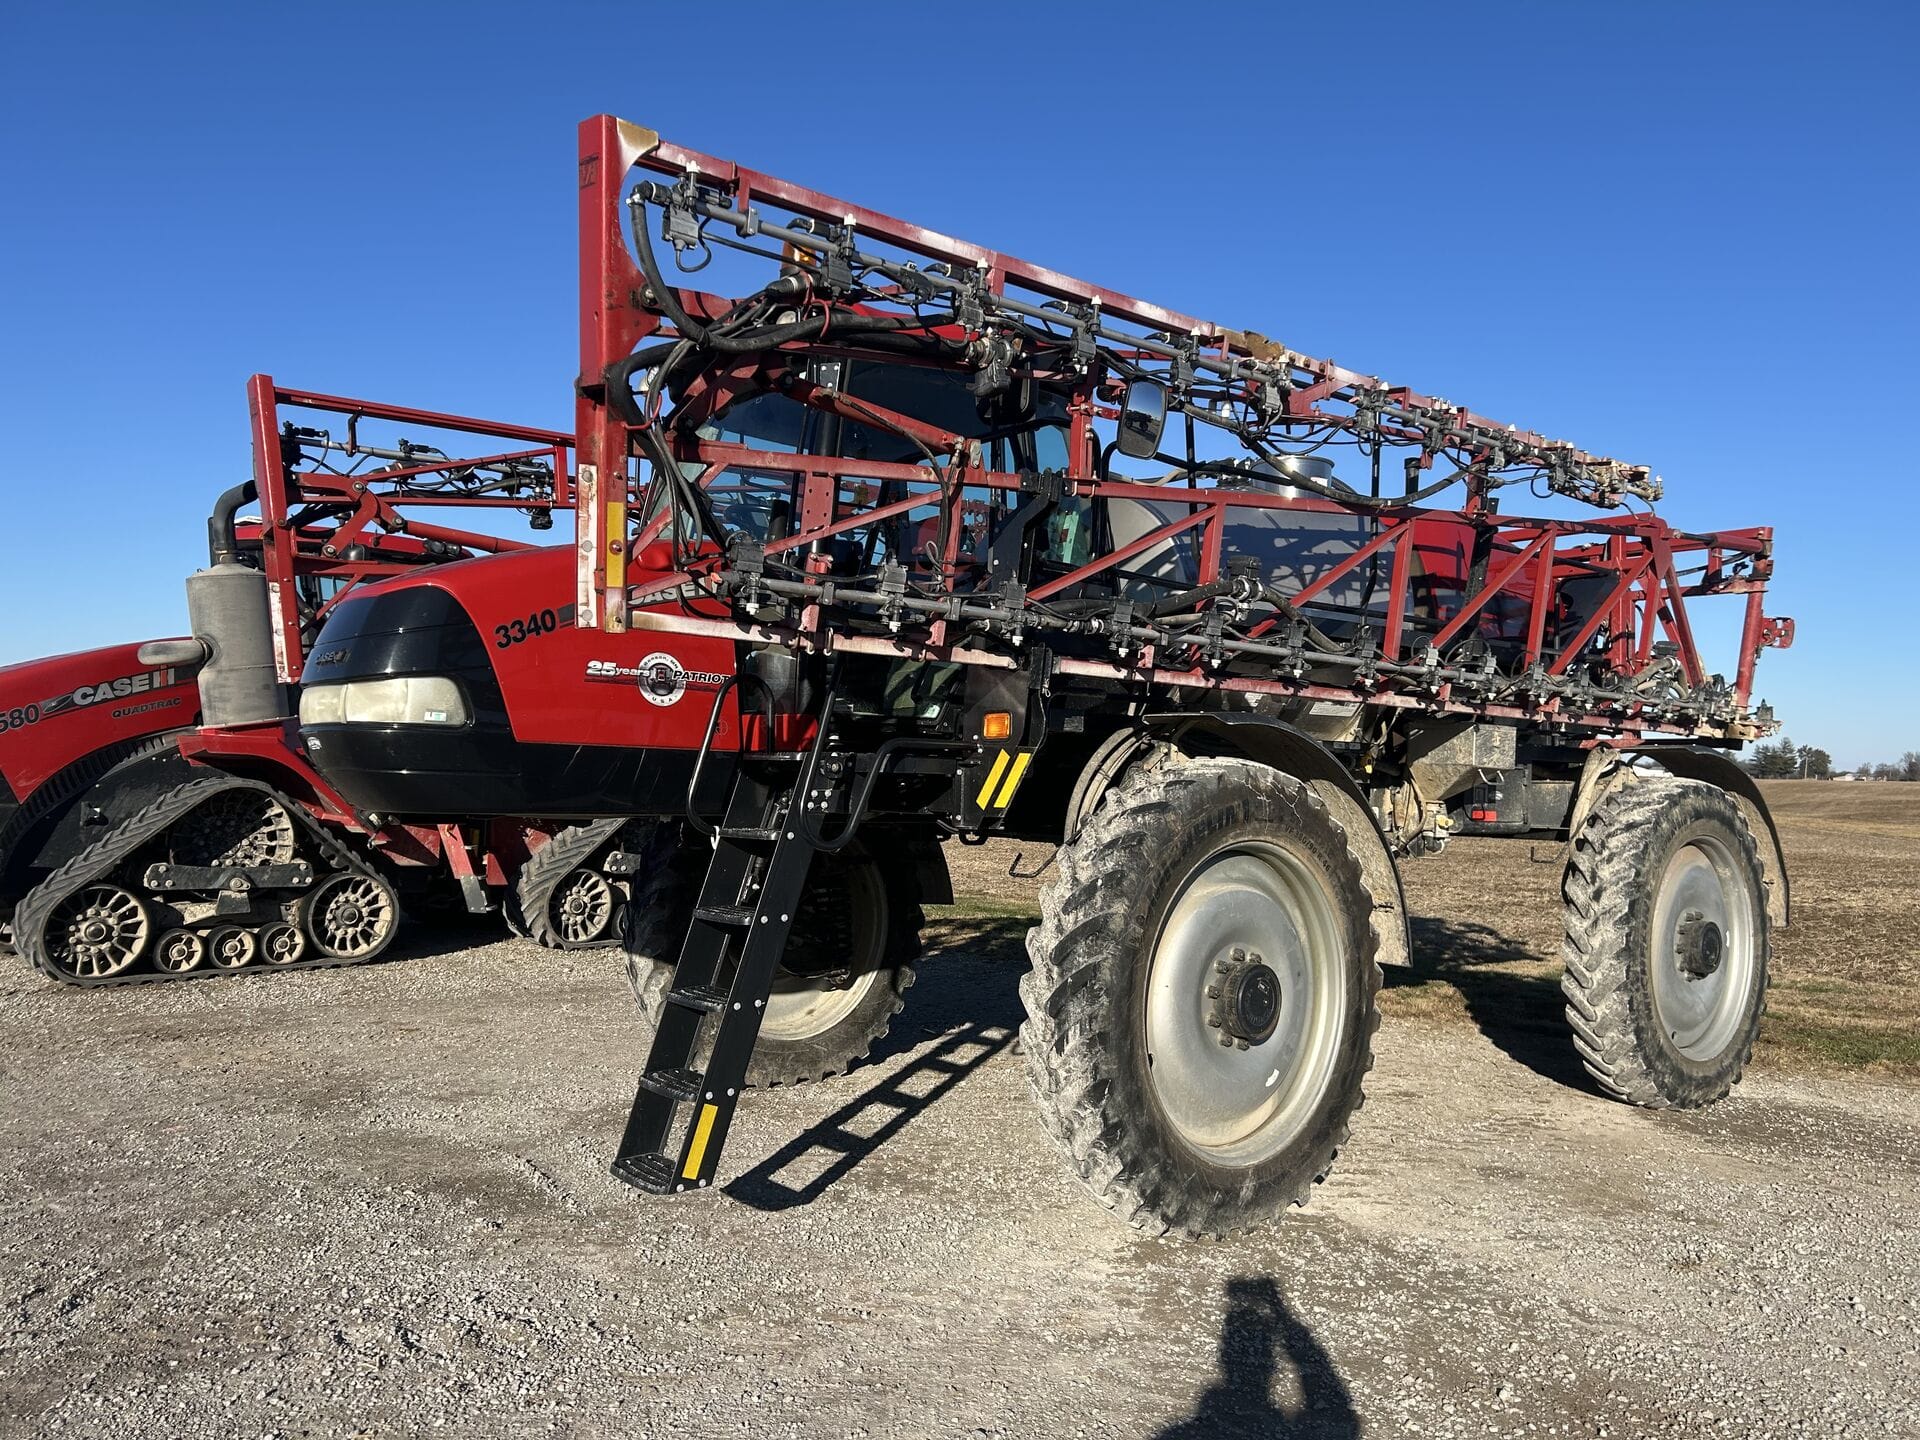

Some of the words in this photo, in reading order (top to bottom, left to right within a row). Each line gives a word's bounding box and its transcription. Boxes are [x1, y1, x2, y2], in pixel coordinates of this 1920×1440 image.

[494, 607, 557, 649] 3340
[72, 673, 150, 706] CASE
[672, 670, 731, 685] PATRIOT
[112, 697, 182, 718] QUADTRAC
